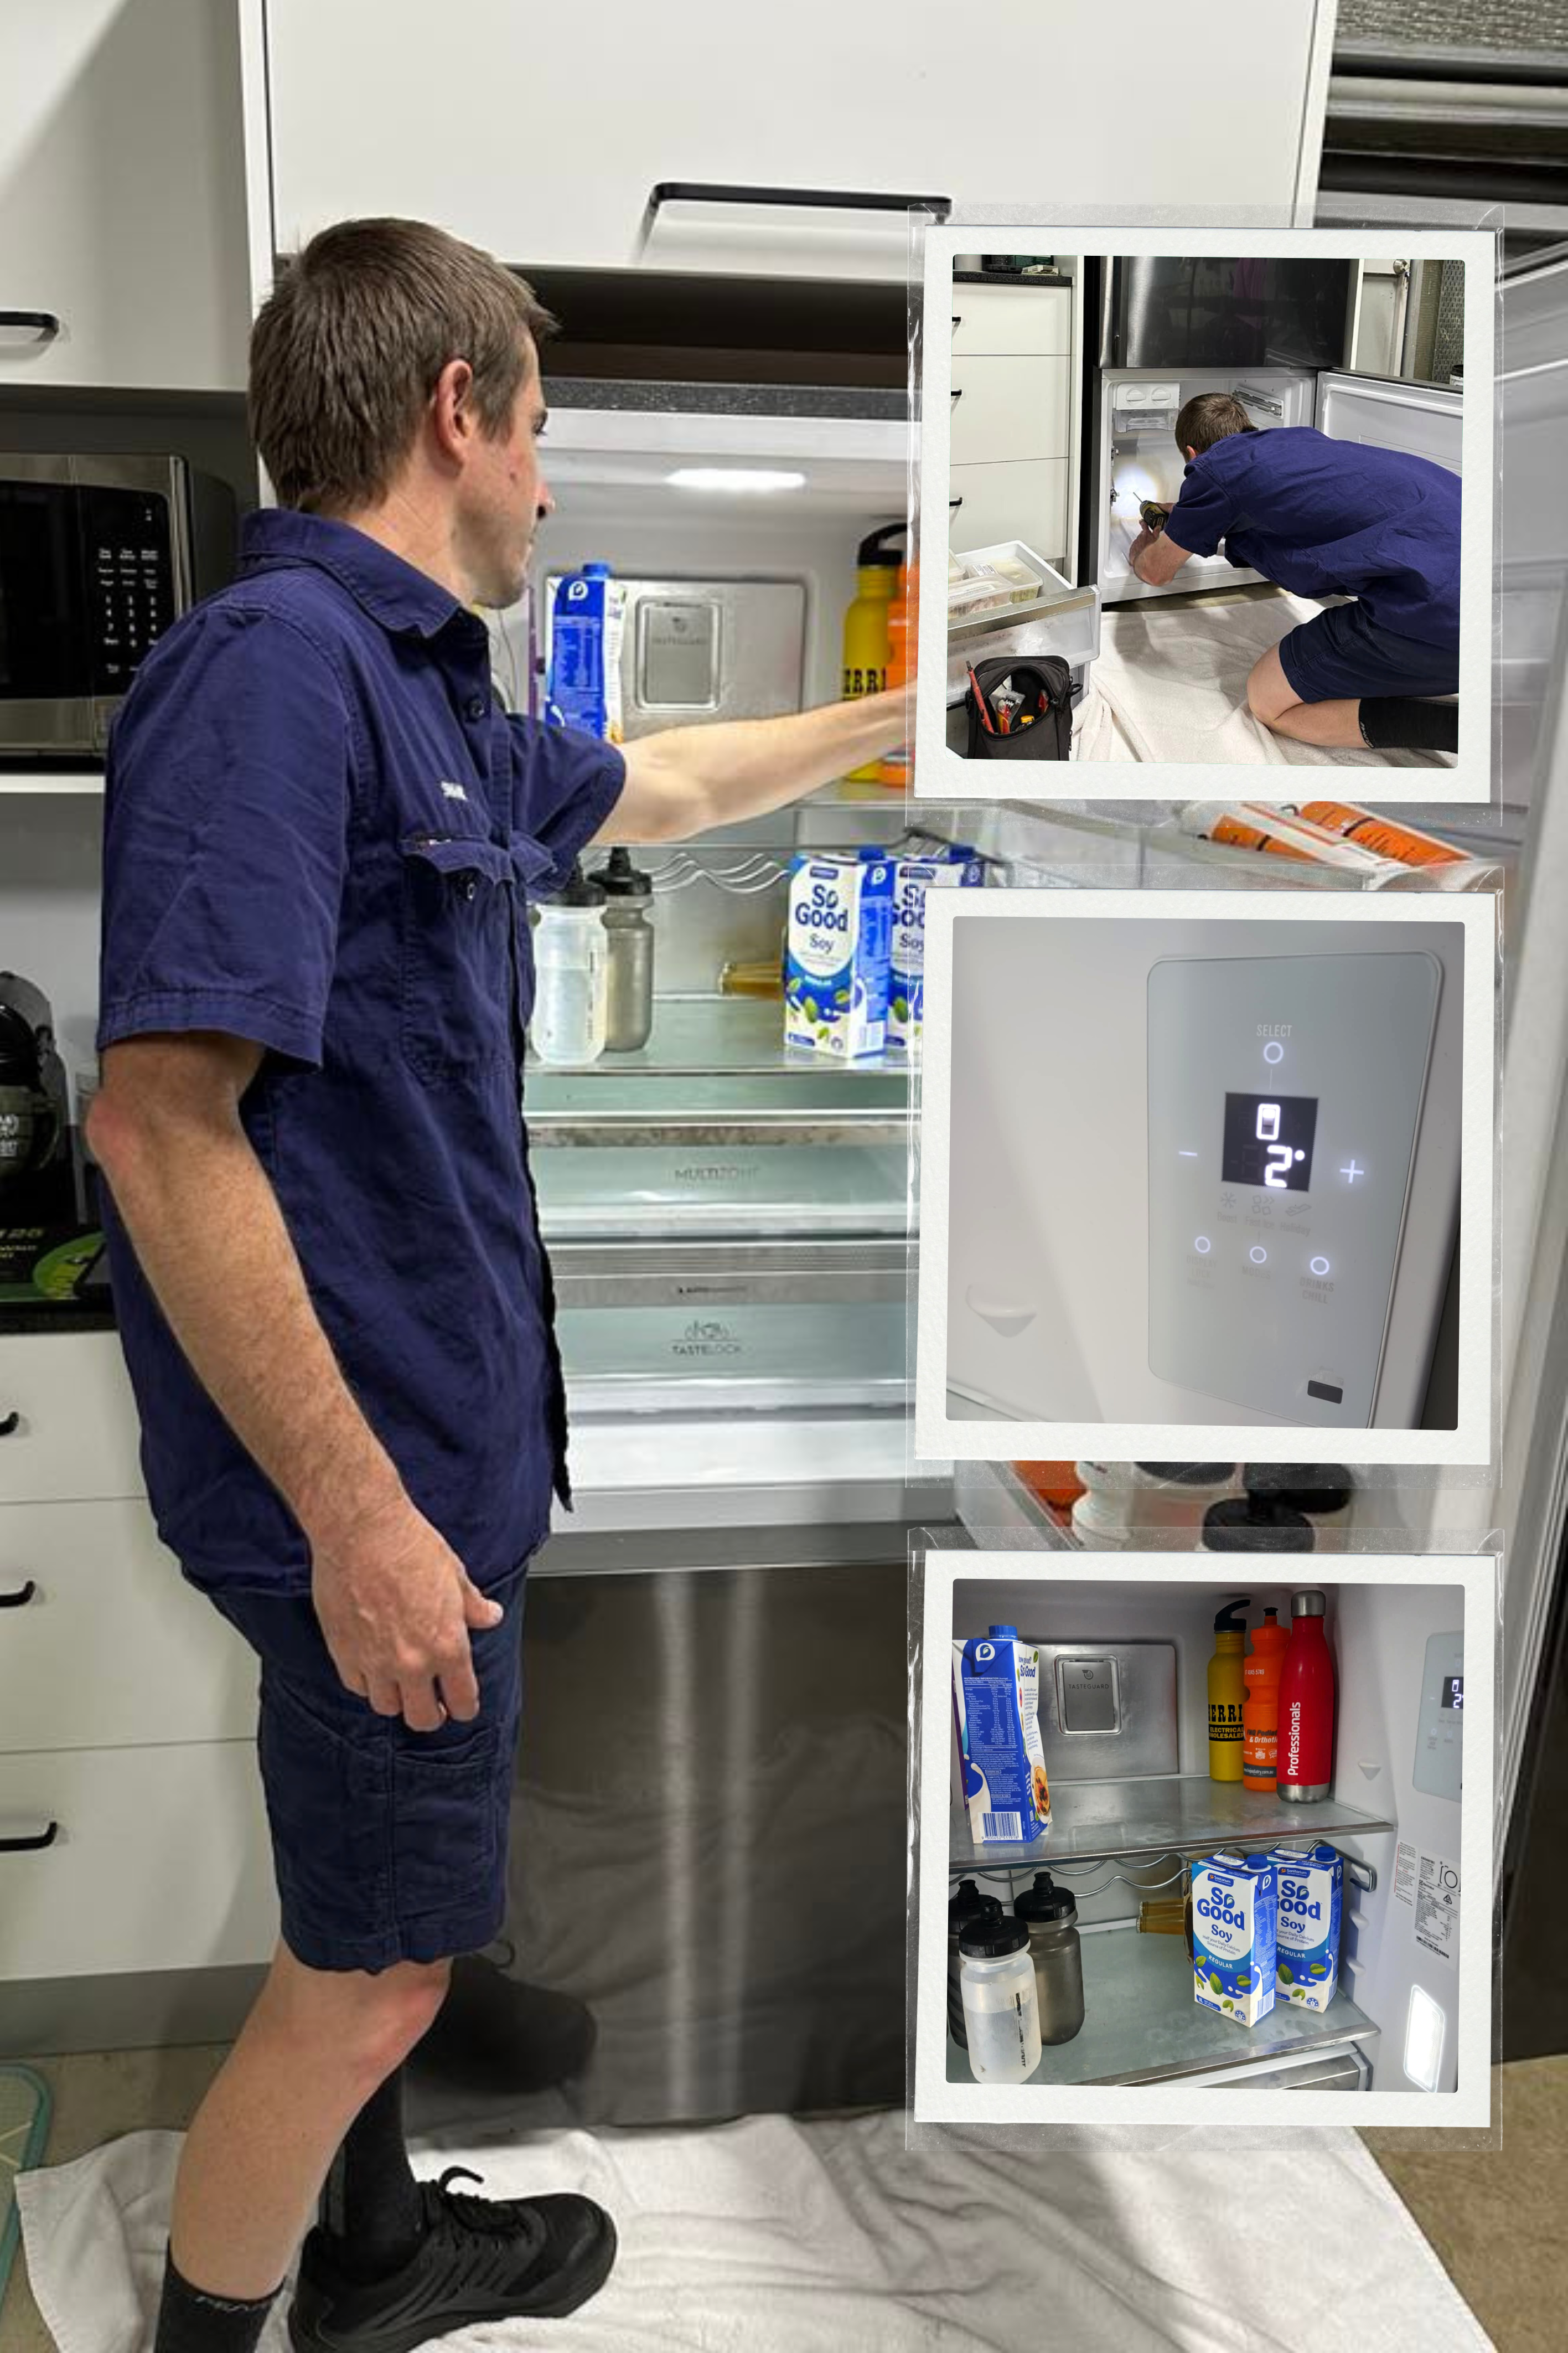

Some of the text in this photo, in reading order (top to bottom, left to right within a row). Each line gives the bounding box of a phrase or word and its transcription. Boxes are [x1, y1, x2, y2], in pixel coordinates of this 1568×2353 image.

[812, 884, 839, 909] So
[795, 902, 848, 932] Good
[810, 933, 834, 953] Soy
[1256, 1024, 1292, 1038] SELECT
[1280, 1221, 1311, 1237] Holiday
[1187, 1255, 1218, 1268] DISPLAY
[1300, 1277, 1334, 1293] DRINKS
[1302, 1289, 1328, 1304] CHILL
[1020, 1664, 1036, 1678] So Good
[1287, 1702, 1301, 1776] Professionals
[1214, 1875, 1231, 1883] Sanitarium
[1211, 1887, 1235, 1909] So
[1281, 1880, 1310, 1900] So
[1197, 1898, 1245, 1931] Good
[1281, 1916, 1305, 1933] Soy
[1211, 1924, 1232, 1943] Soy
[1223, 1947, 1236, 1955] Protein
[1227, 1943, 1240, 1952] Calcium
[1277, 1947, 1306, 1958] REGULAR
[1208, 1955, 1233, 1969] REGULAR
